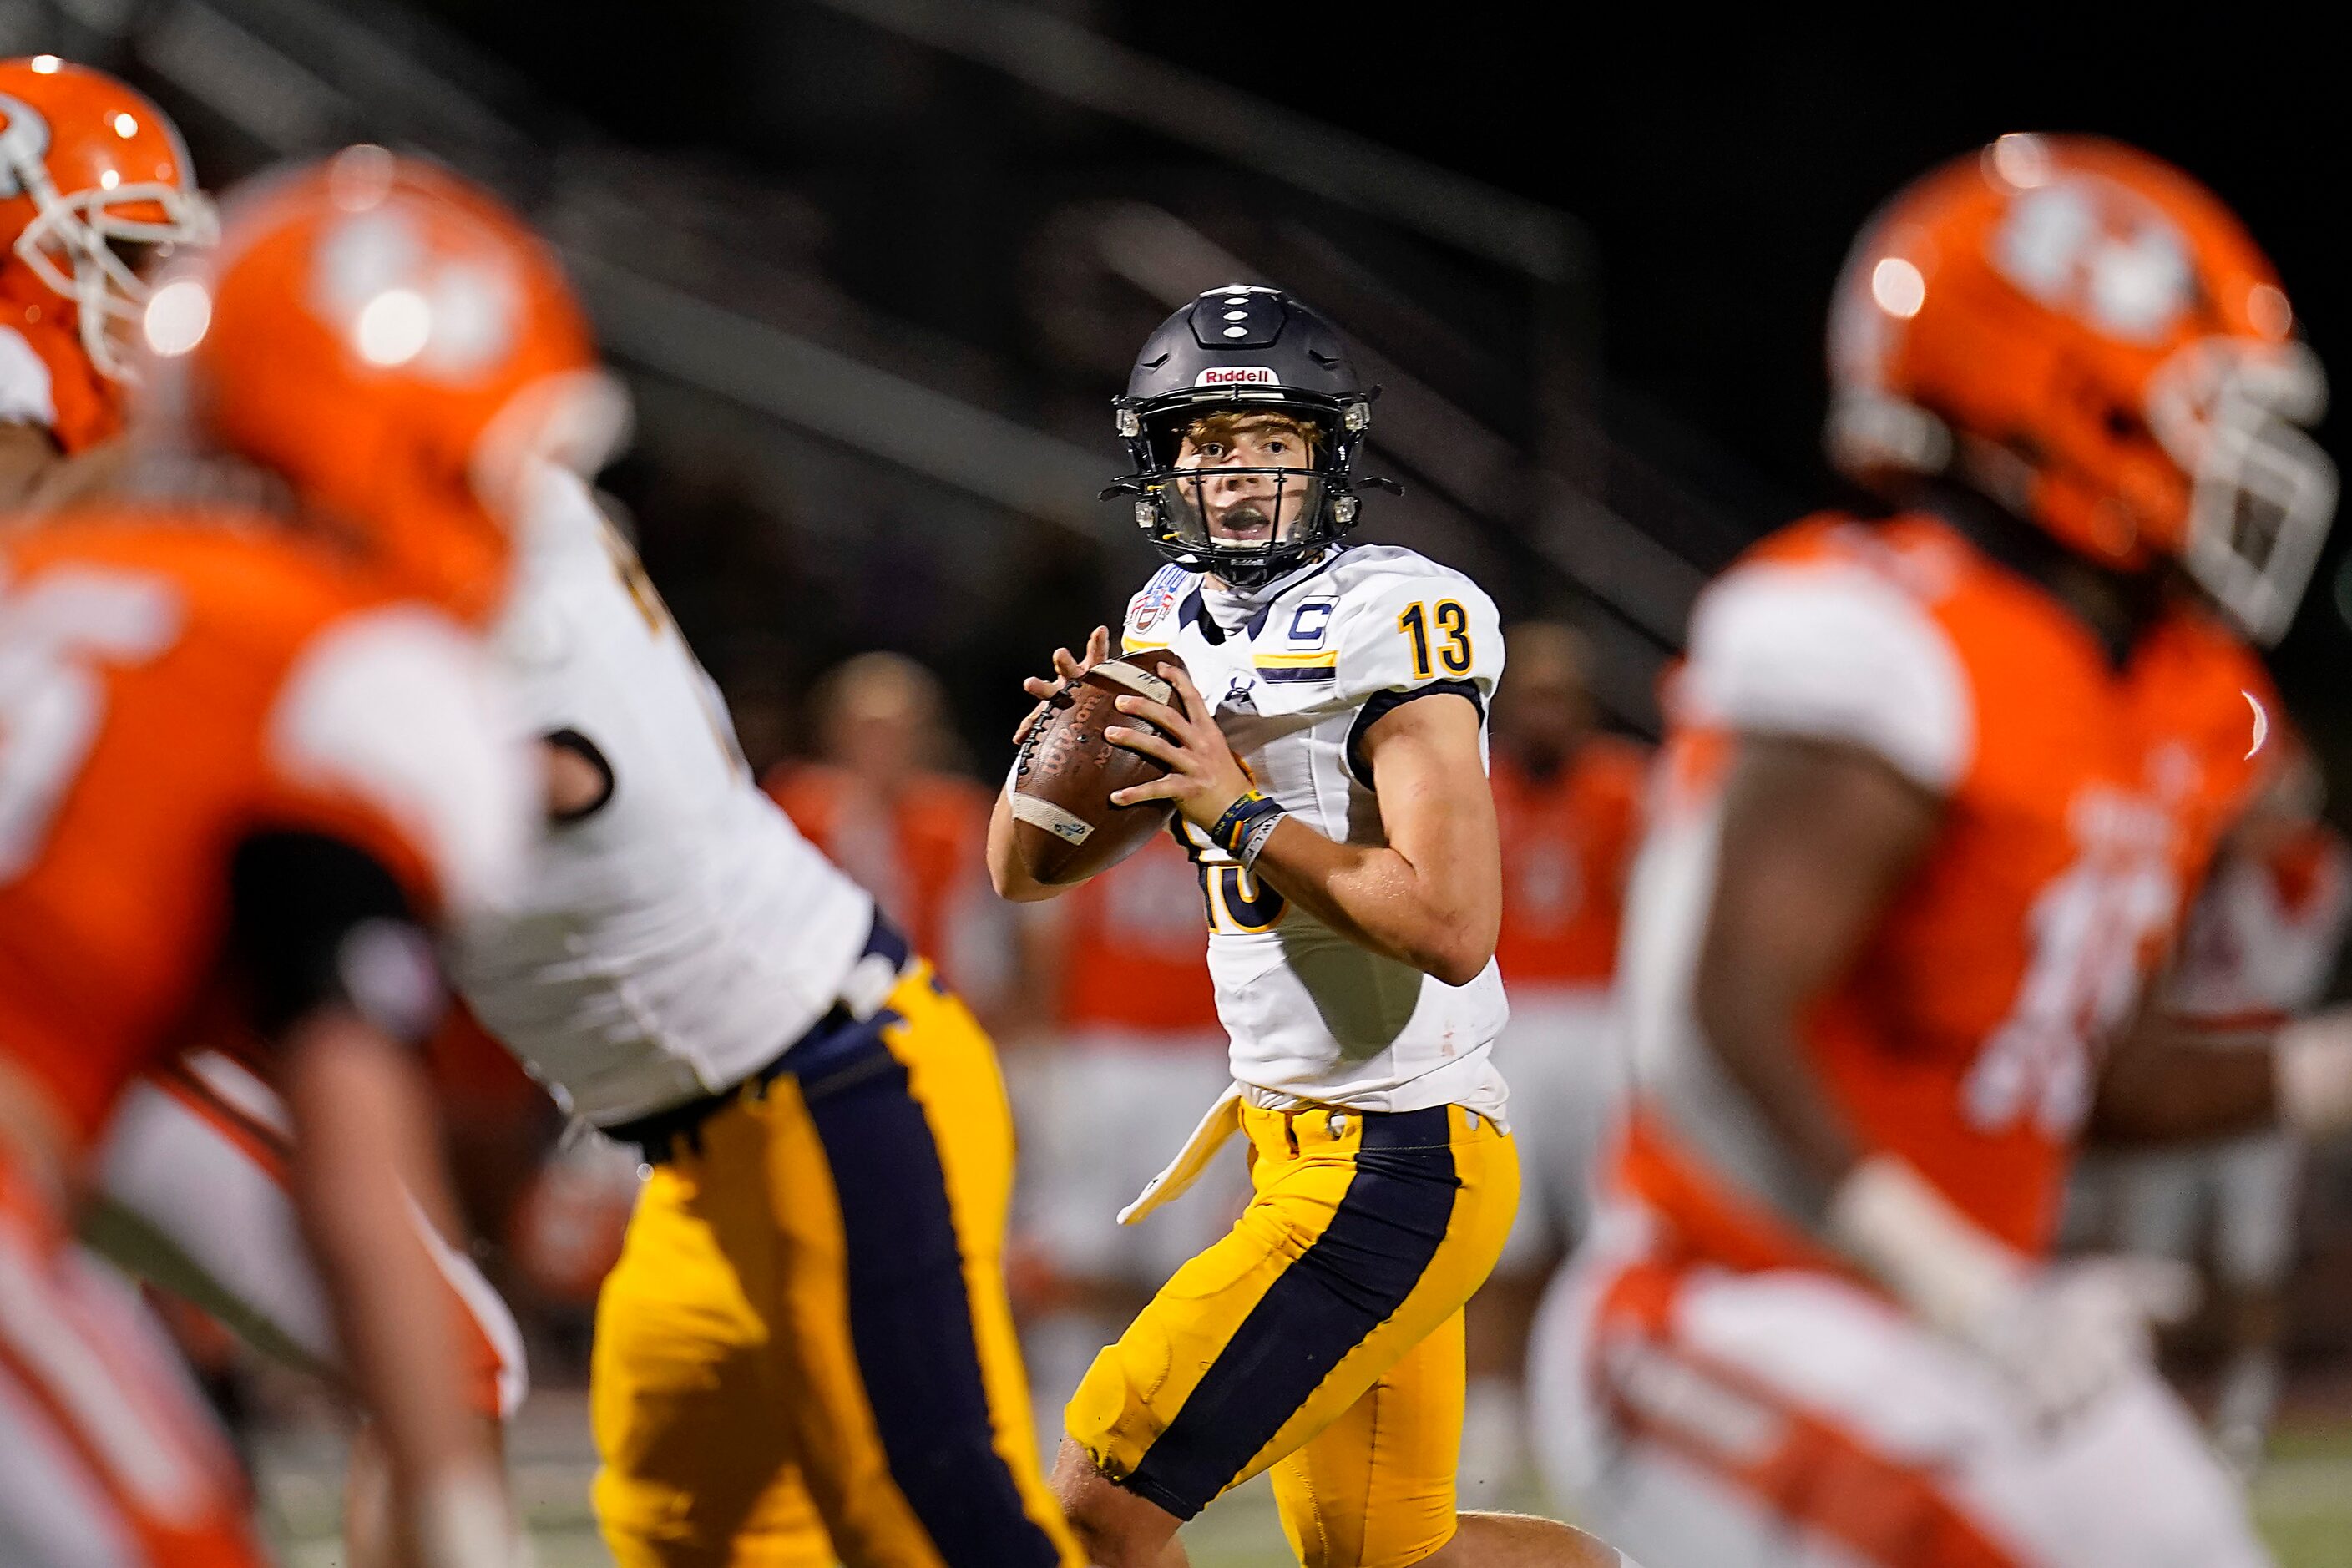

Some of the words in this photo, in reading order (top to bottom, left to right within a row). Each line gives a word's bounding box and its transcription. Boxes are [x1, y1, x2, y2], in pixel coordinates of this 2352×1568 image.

[1206, 369, 1268, 383] Riddell
[1288, 604, 1332, 640] C
[1398, 598, 1473, 680] 13
[1040, 695, 1100, 776] Wilson
